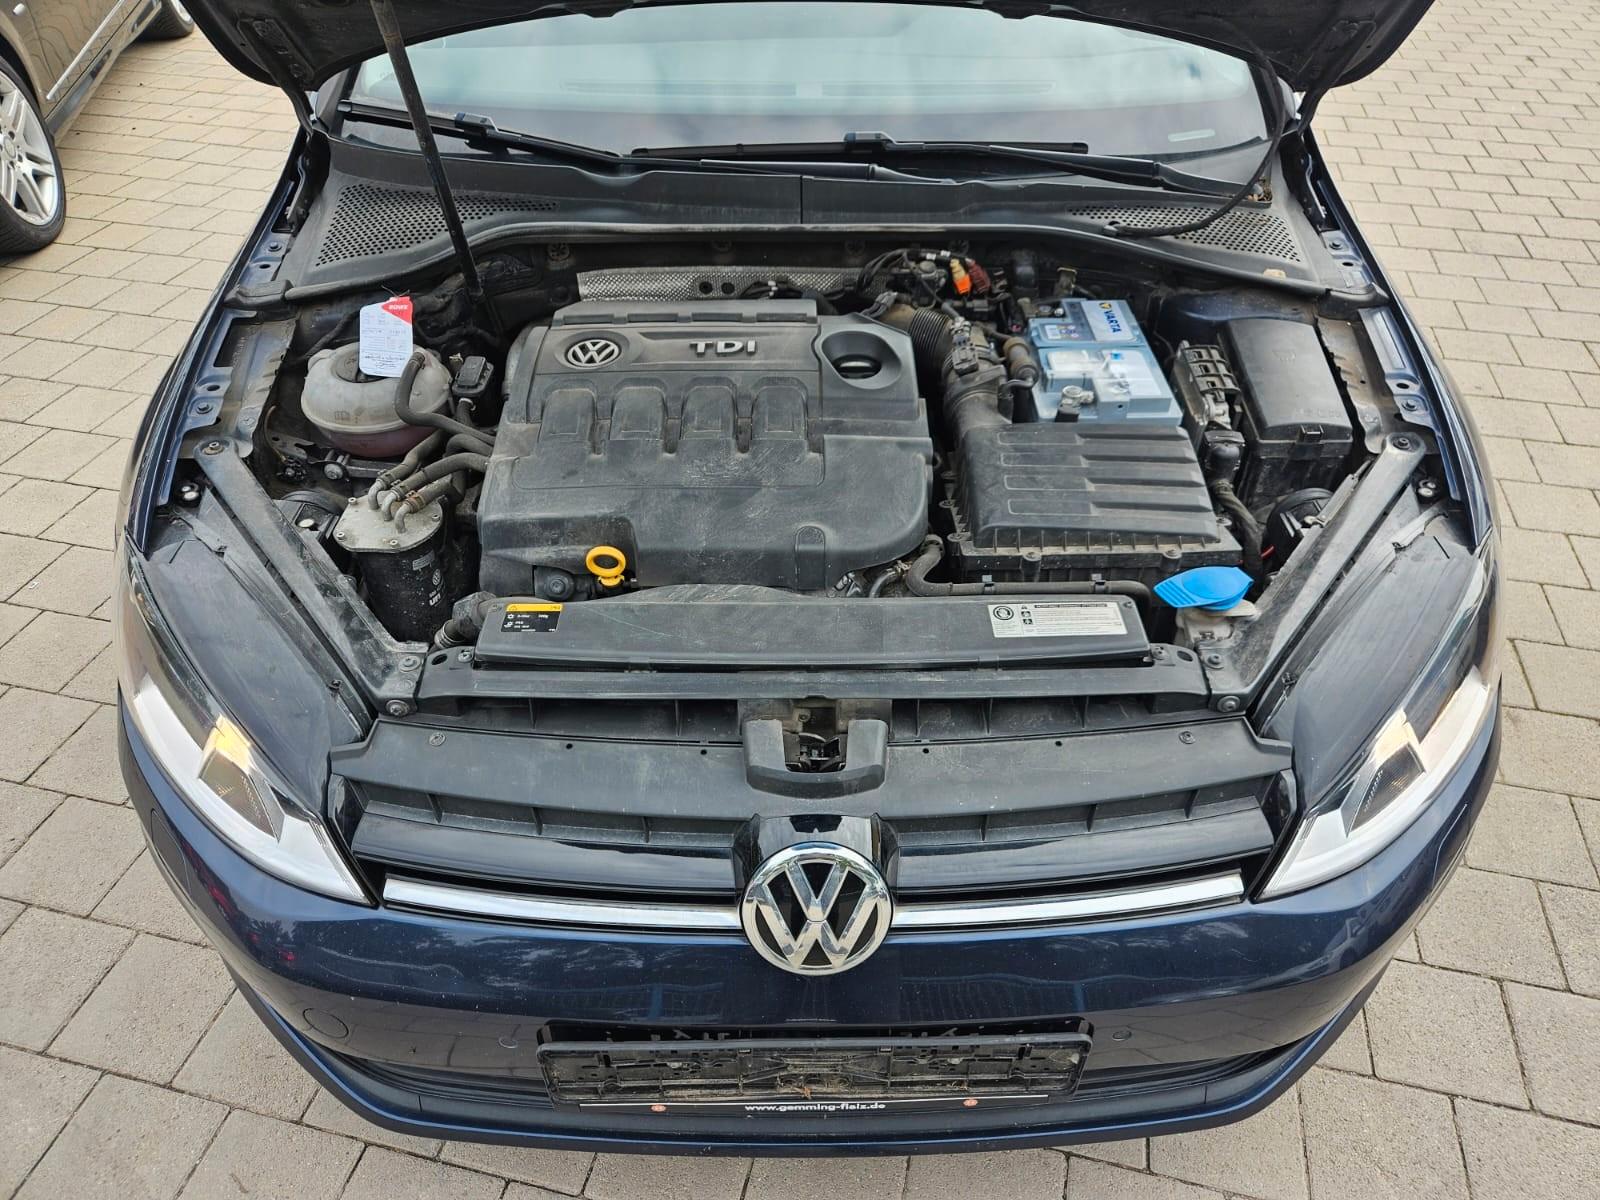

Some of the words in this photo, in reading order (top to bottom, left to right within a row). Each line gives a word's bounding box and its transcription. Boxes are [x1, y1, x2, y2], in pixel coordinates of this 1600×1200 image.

[1103, 309, 1121, 333] VARTA
[566, 338, 621, 368] VW
[690, 340, 756, 354] TDI
[740, 841, 894, 976] VW
